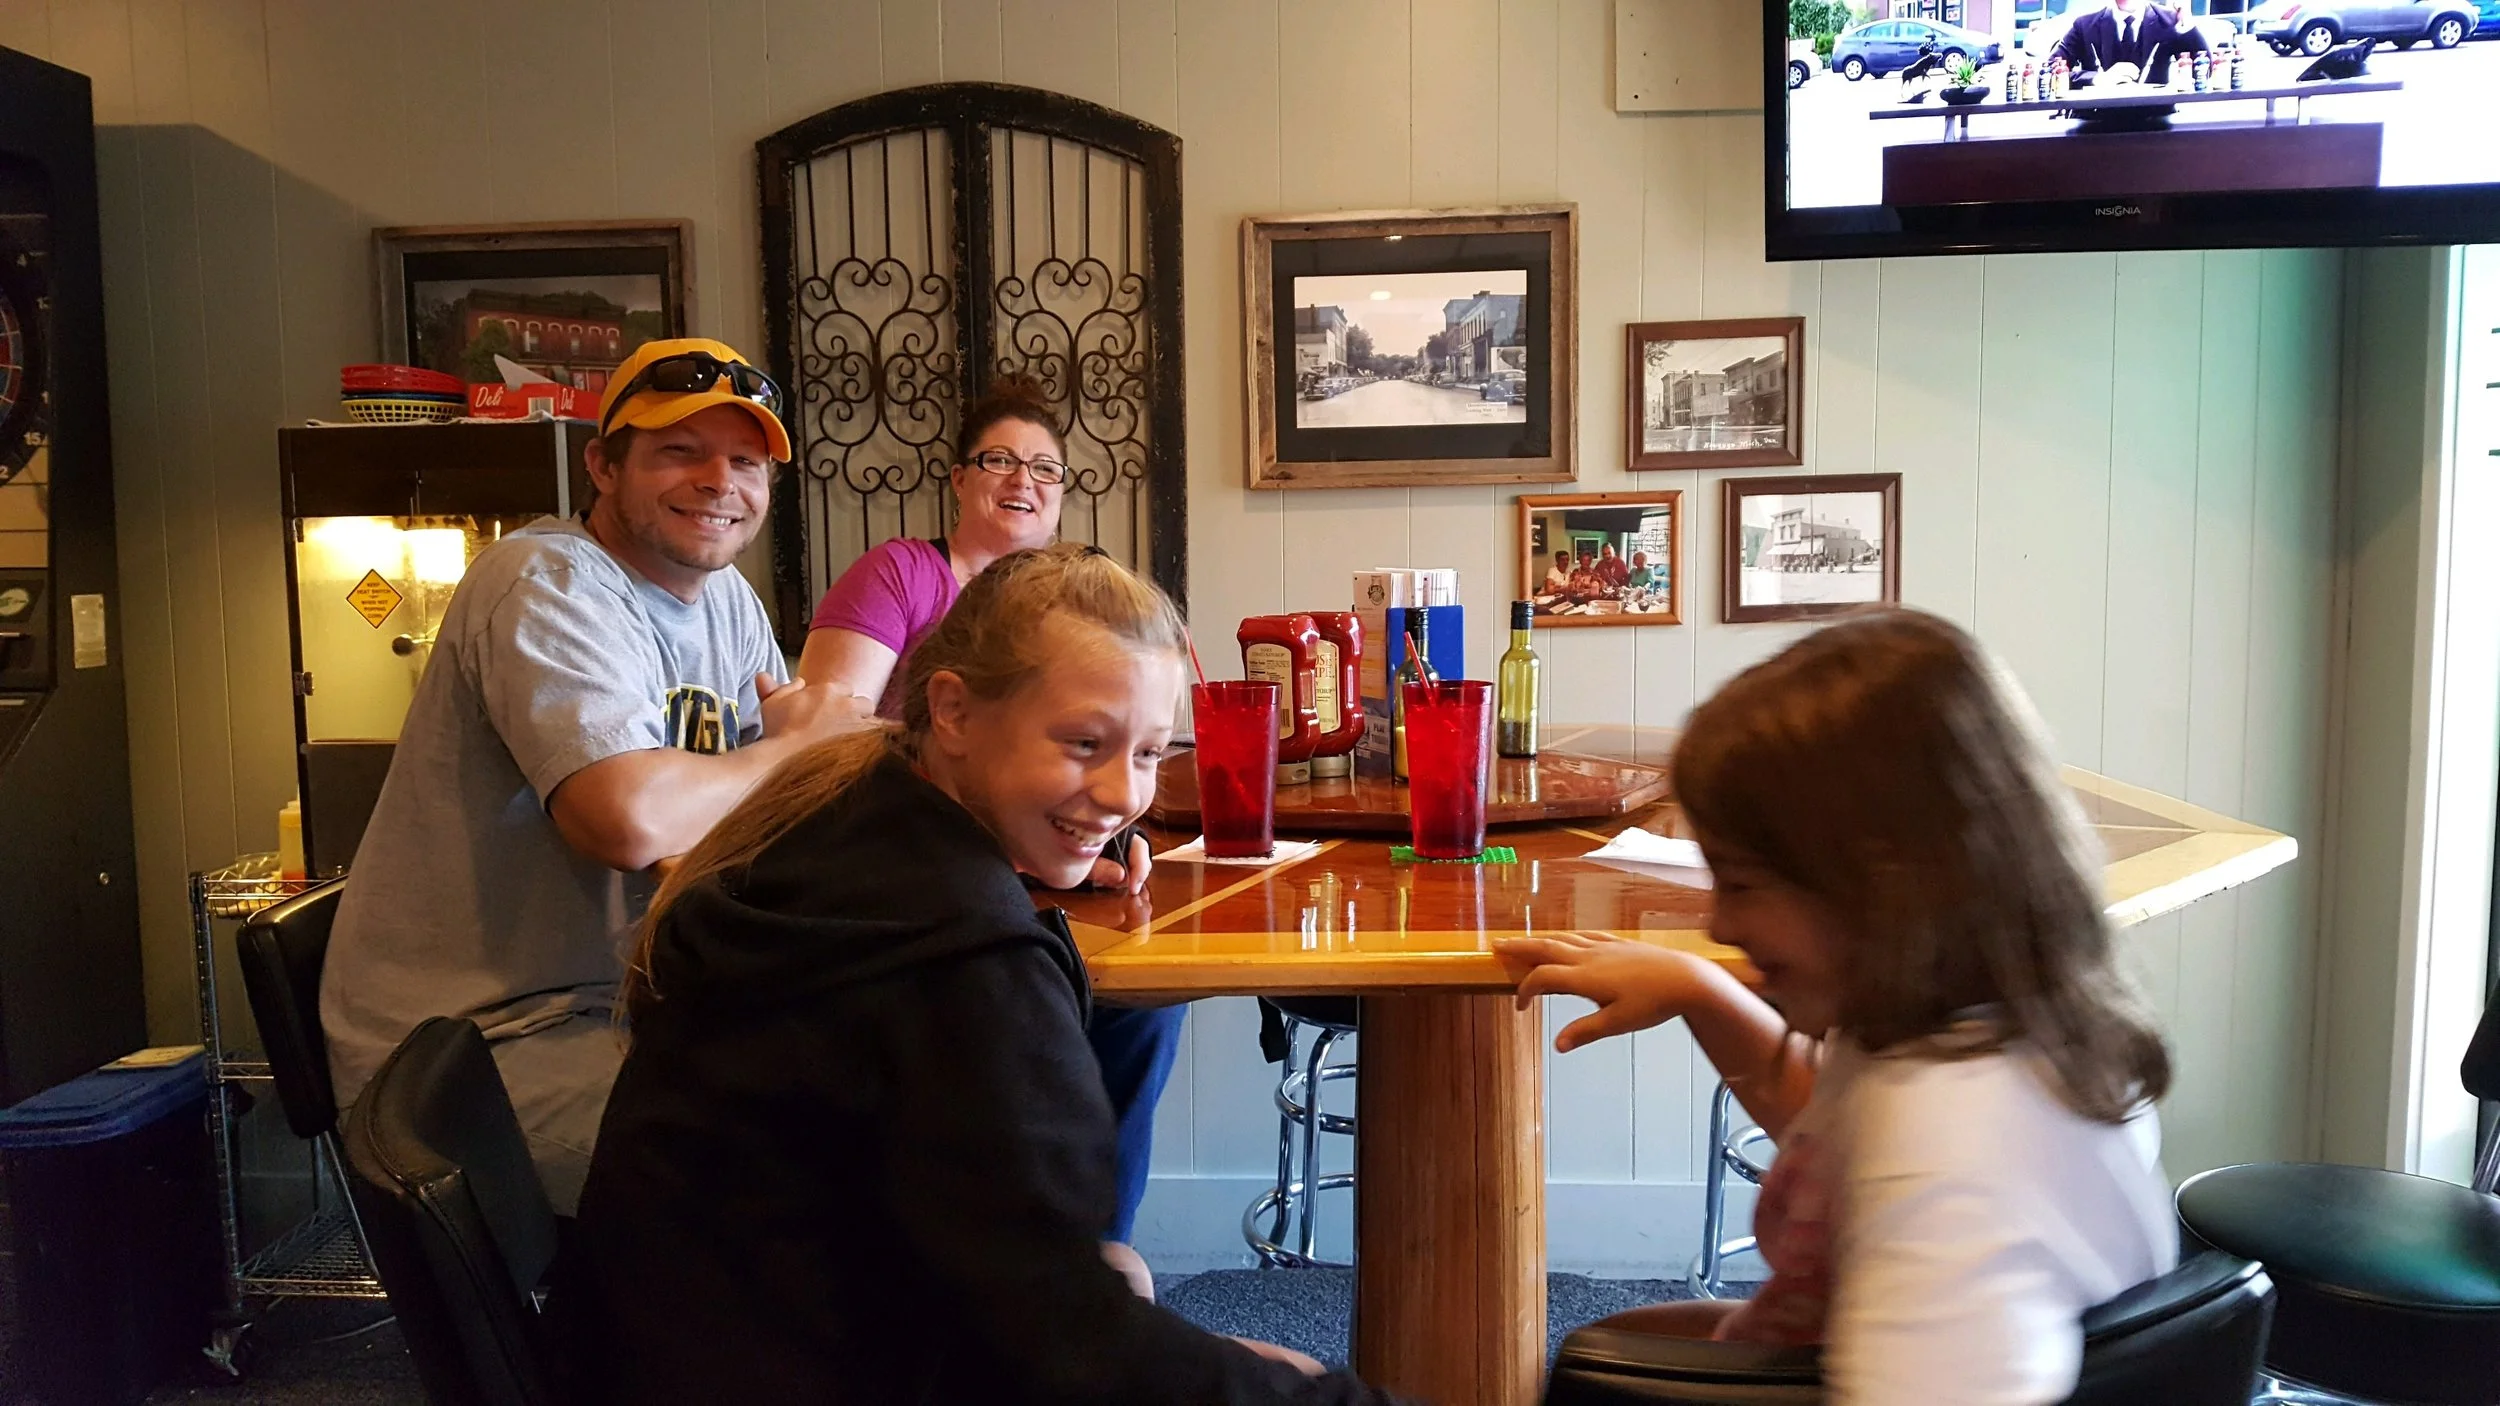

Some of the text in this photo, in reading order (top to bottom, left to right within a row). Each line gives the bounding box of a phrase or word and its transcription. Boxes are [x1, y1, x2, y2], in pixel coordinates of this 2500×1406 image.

[2095, 205, 2141, 217] INSIGNIA
[475, 386, 504, 408] Deli
[23, 431, 41, 446] 15
